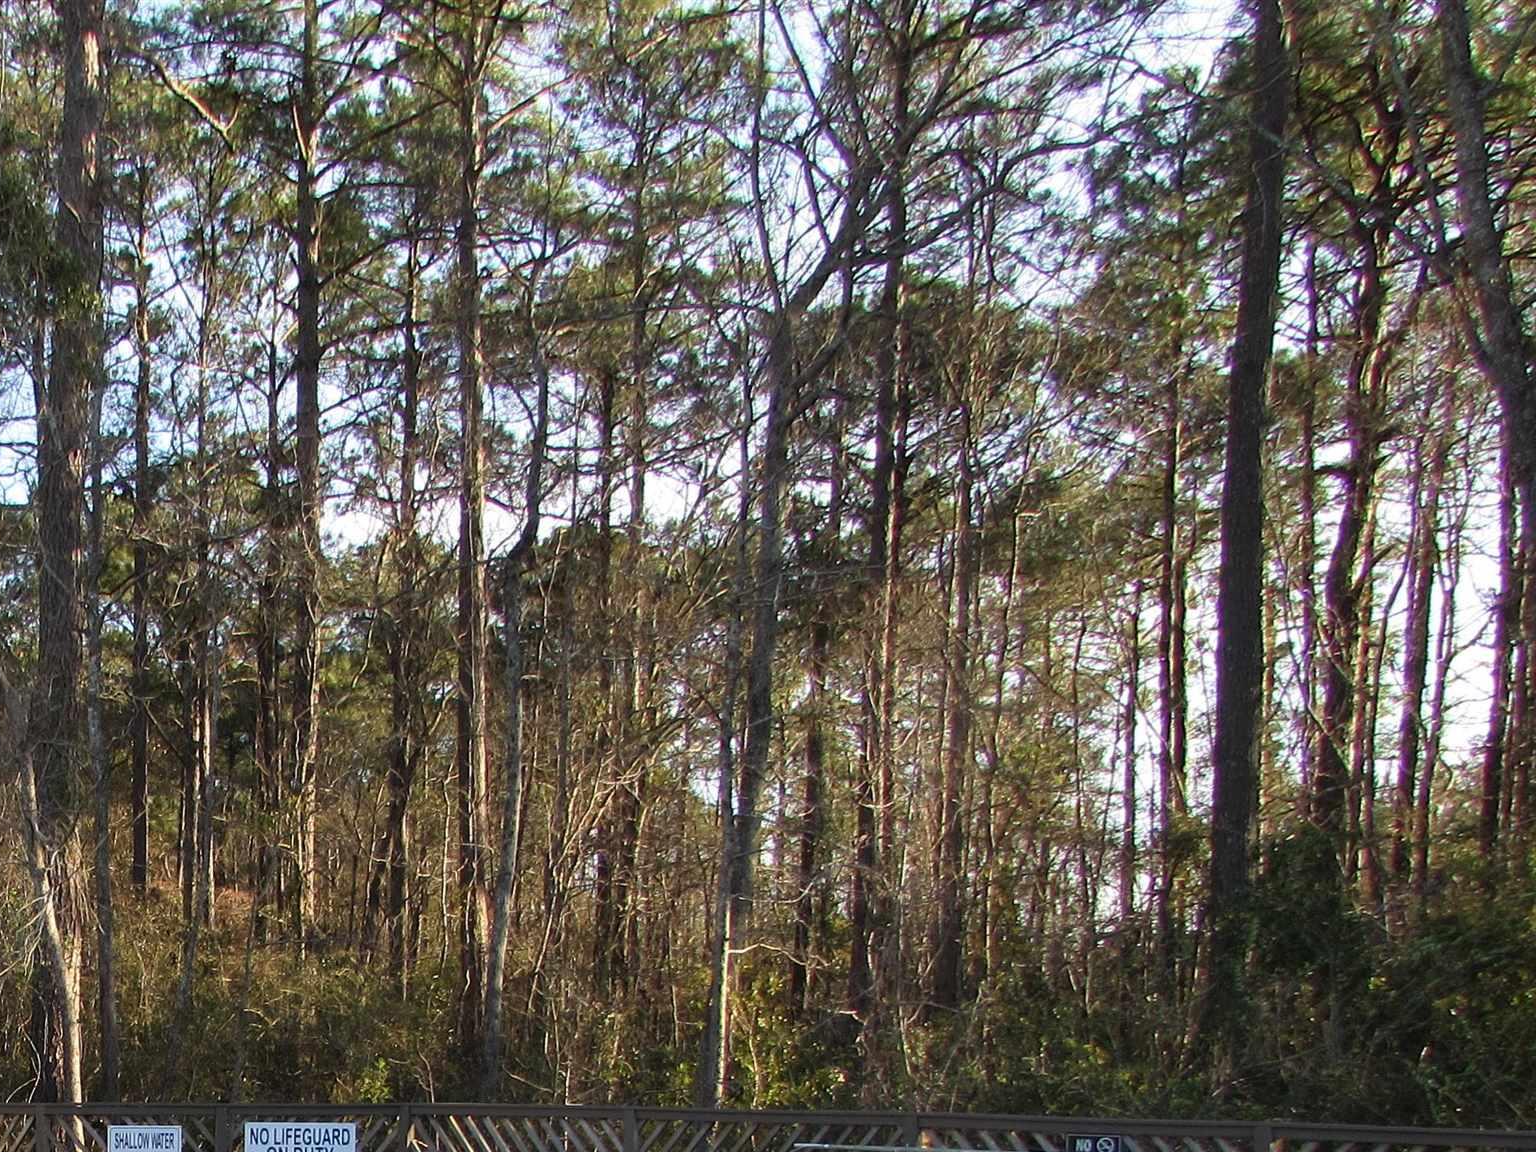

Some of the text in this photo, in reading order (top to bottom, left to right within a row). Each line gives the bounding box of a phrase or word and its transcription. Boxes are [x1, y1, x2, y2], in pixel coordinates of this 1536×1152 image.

[114, 1132, 174, 1149] SHALLOW WATER
[250, 1127, 350, 1146] NO LIFEGUARD
[1075, 1138, 1092, 1152] NO
